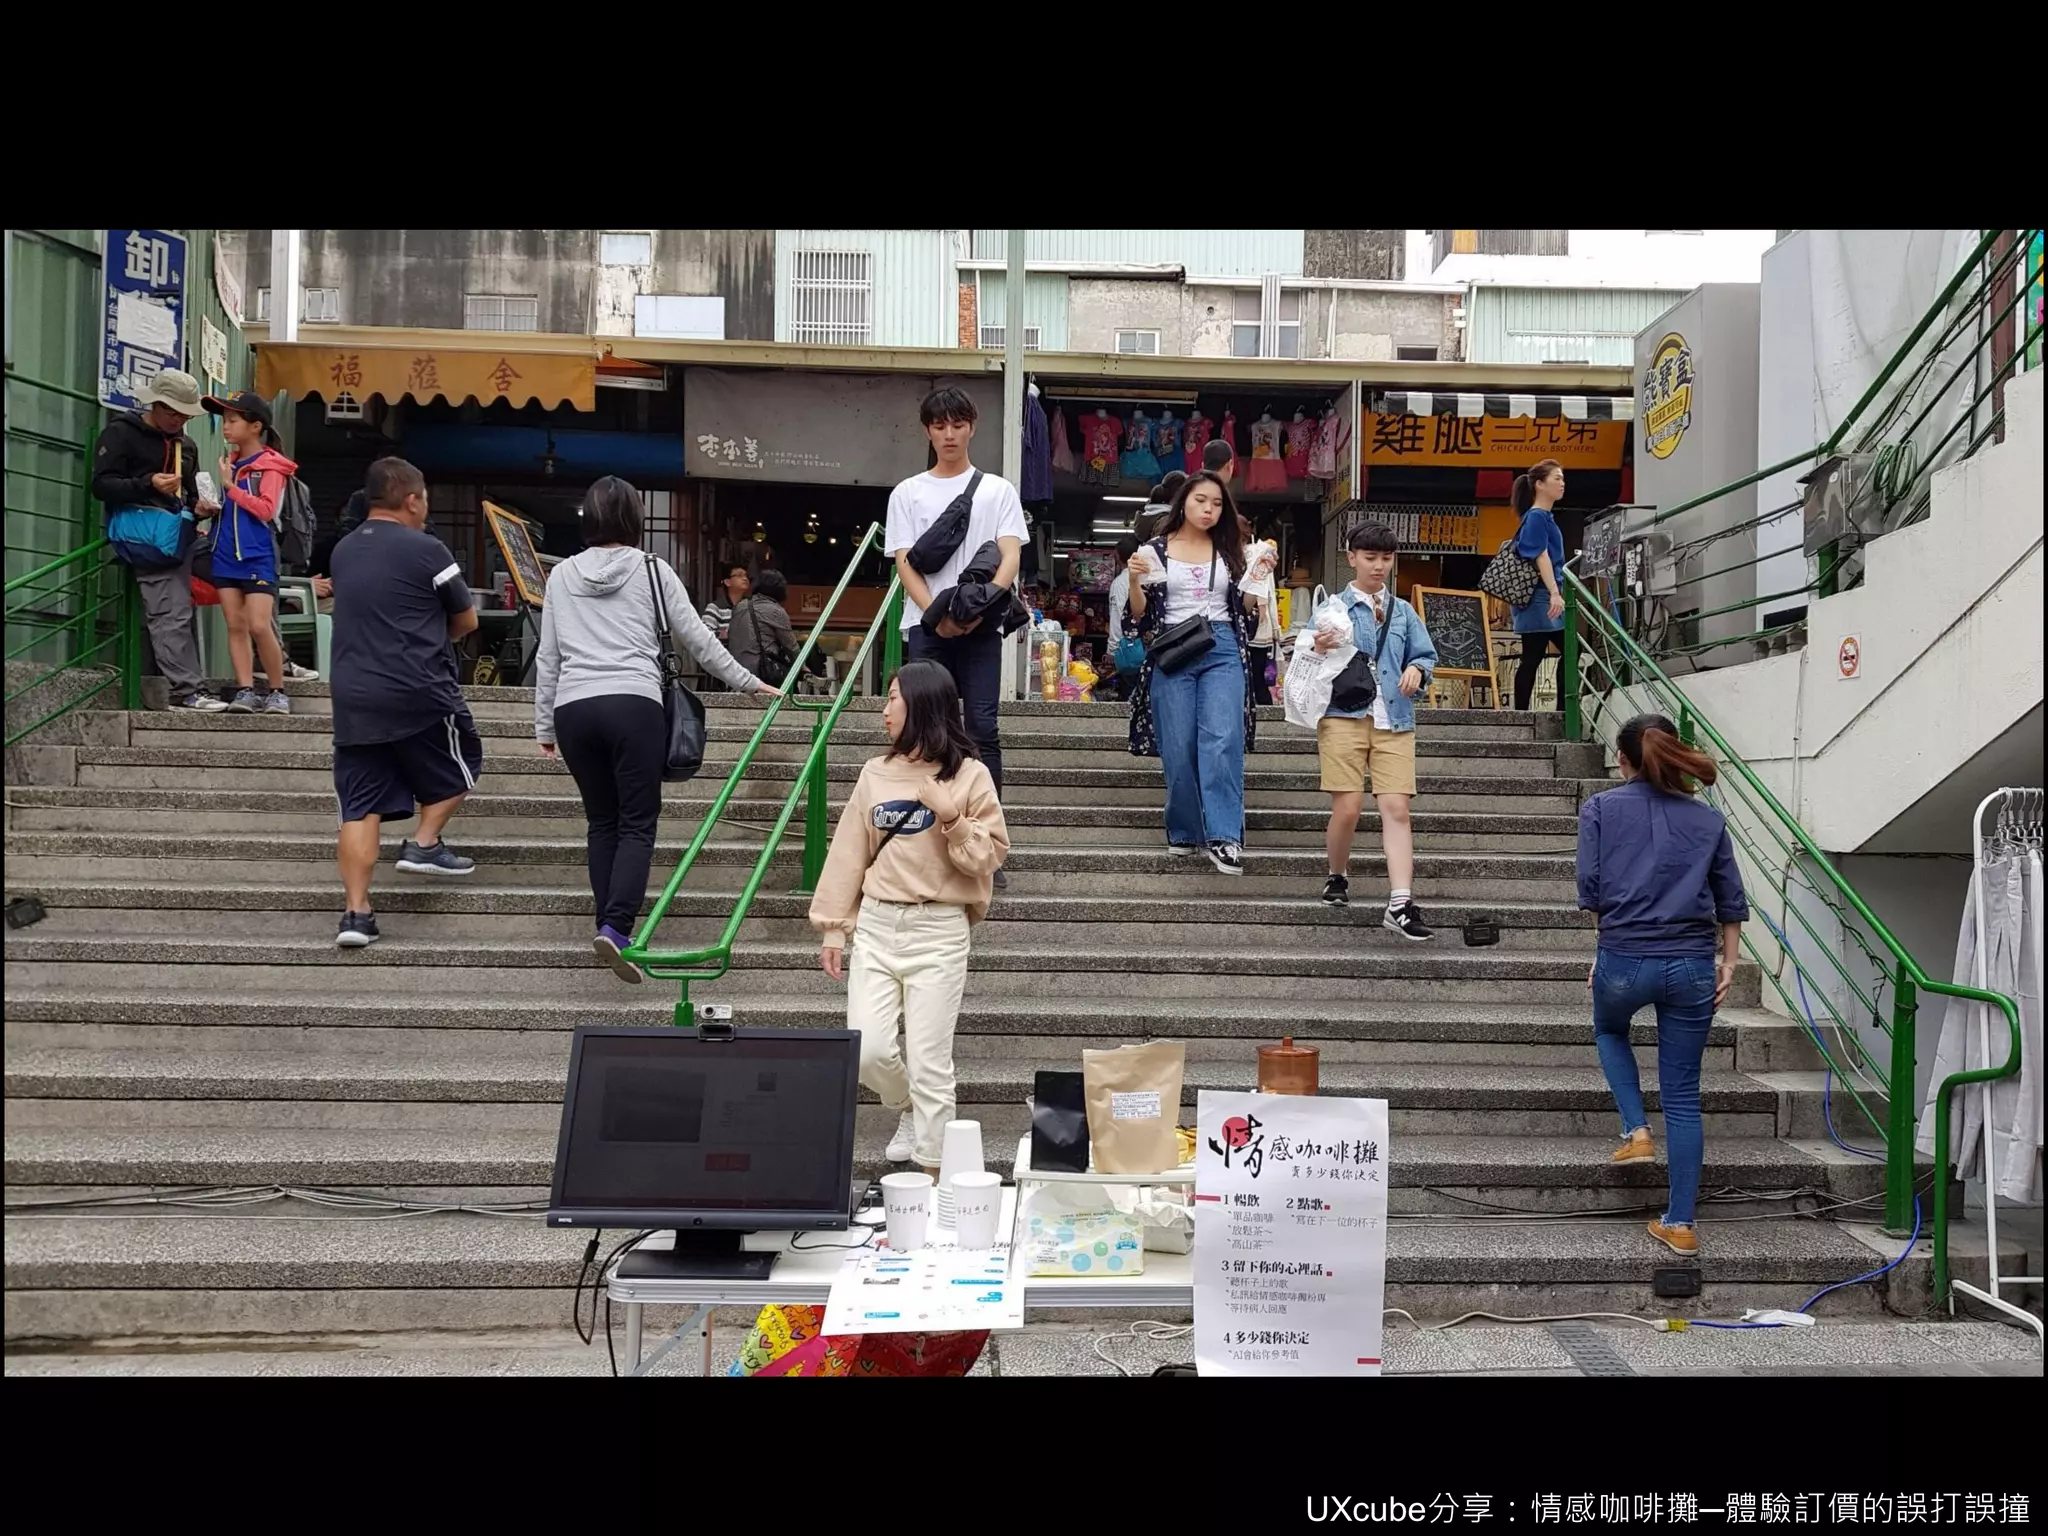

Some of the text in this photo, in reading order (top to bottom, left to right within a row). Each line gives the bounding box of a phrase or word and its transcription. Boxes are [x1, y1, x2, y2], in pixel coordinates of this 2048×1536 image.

[1490, 444, 1596, 453] CHICKENLEG BROTHERS
[1223, 1193, 1261, 1208] 1 暢飲
[1285, 1197, 1324, 1211] 2 點歌
[1221, 1259, 1324, 1277] 3 留下你的心裡話
[1223, 1330, 1310, 1346] 4 多少錢你決定
